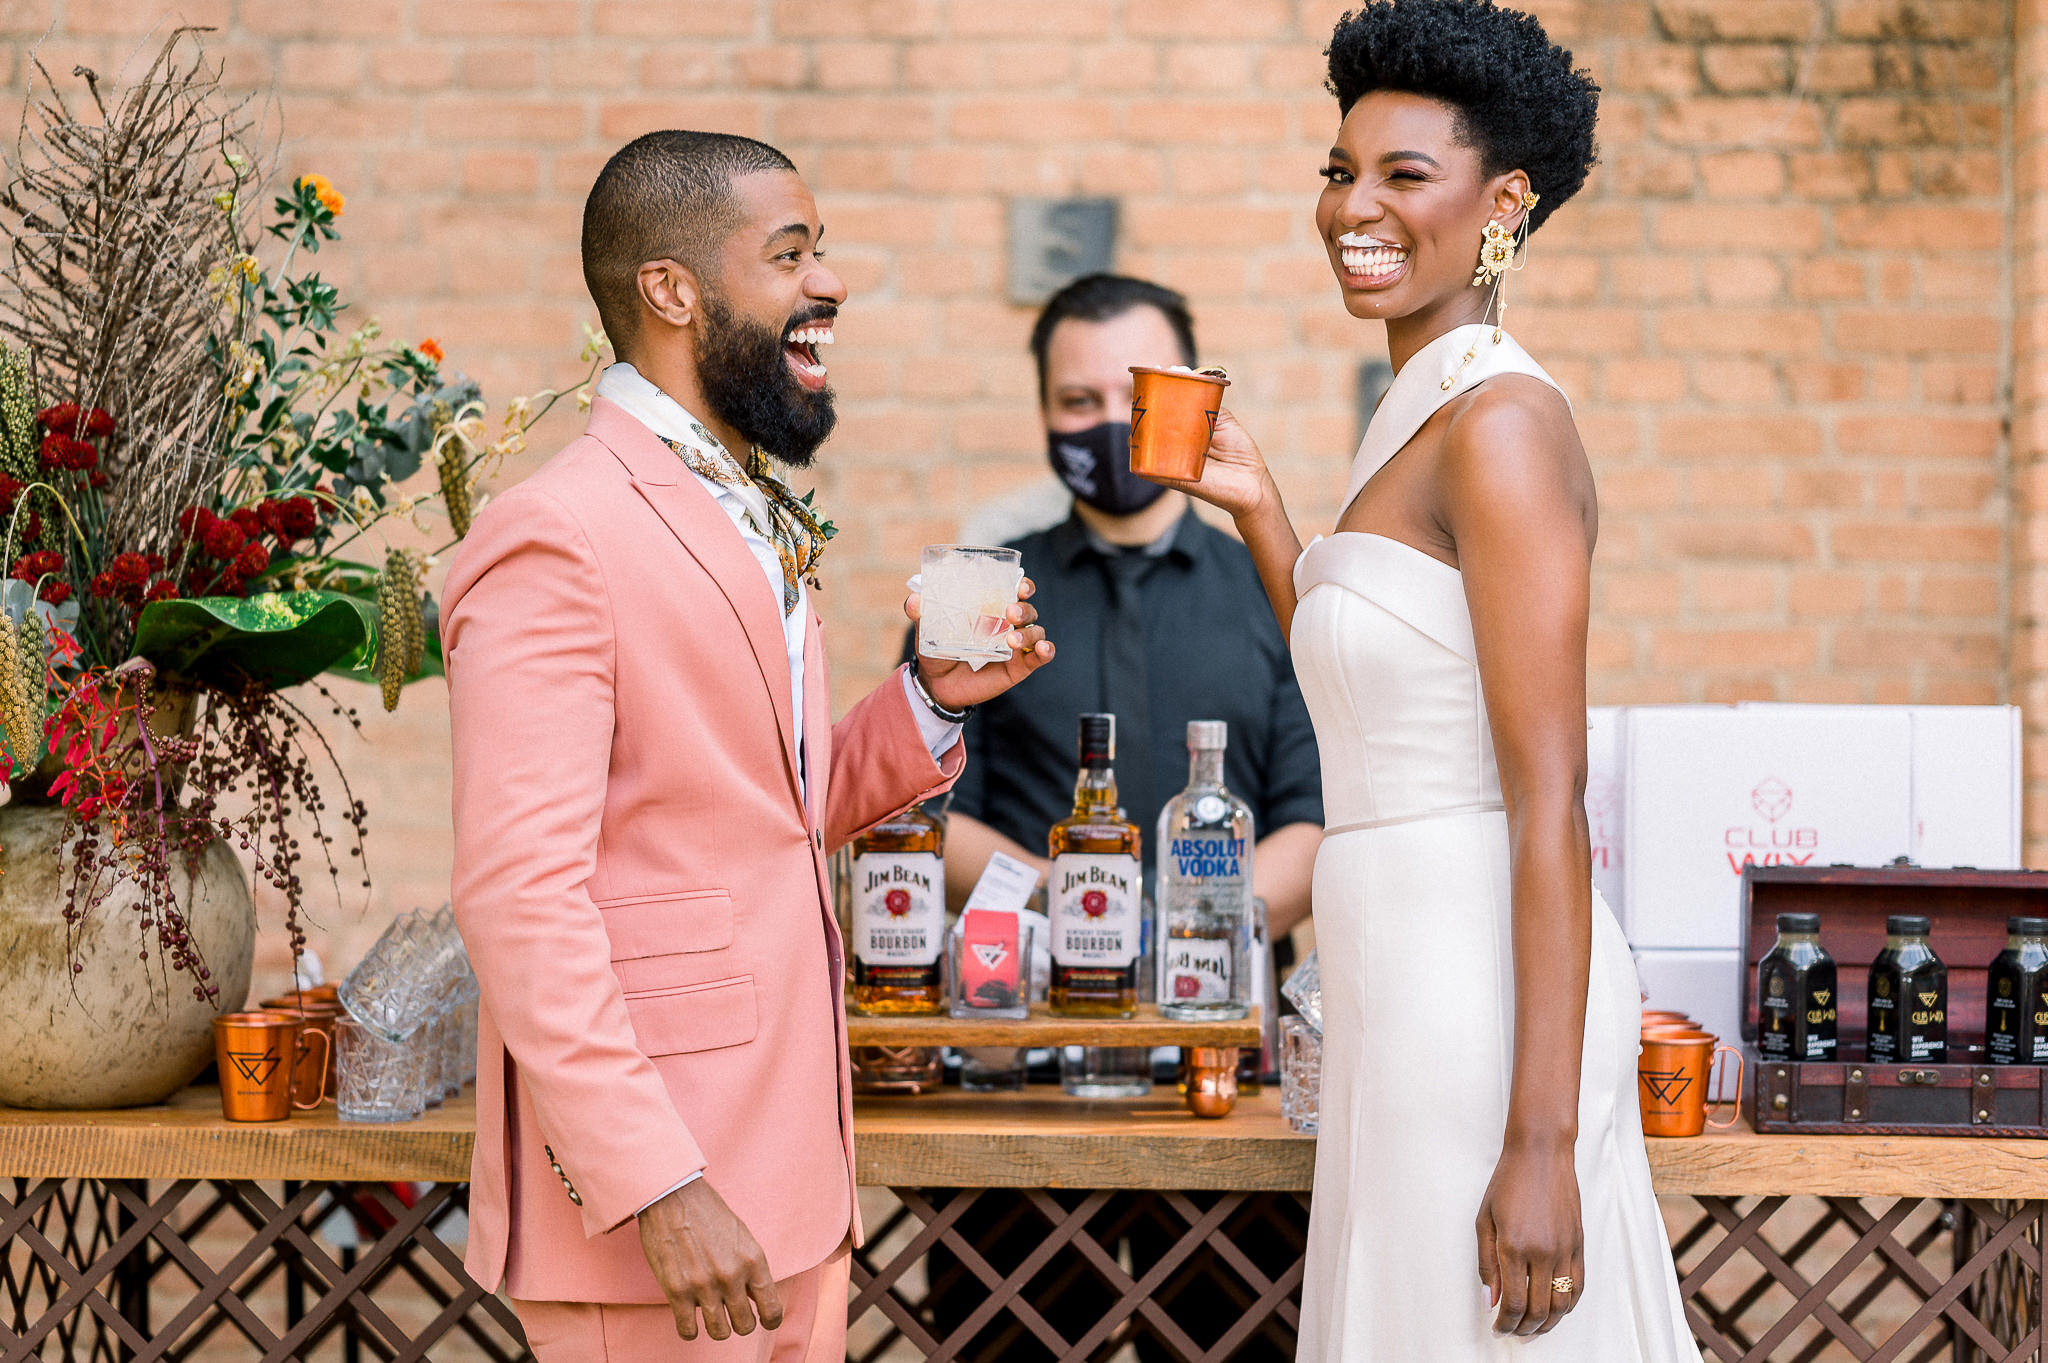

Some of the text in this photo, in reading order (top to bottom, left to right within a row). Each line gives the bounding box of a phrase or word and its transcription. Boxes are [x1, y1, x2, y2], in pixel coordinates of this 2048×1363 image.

[1725, 828, 1818, 848] CLUB
[1171, 839, 1245, 857] ABSOLUT
[1179, 858, 1240, 877] VODKA
[870, 936, 927, 949] BOURBON
[1066, 937, 1122, 950] BOURBON
